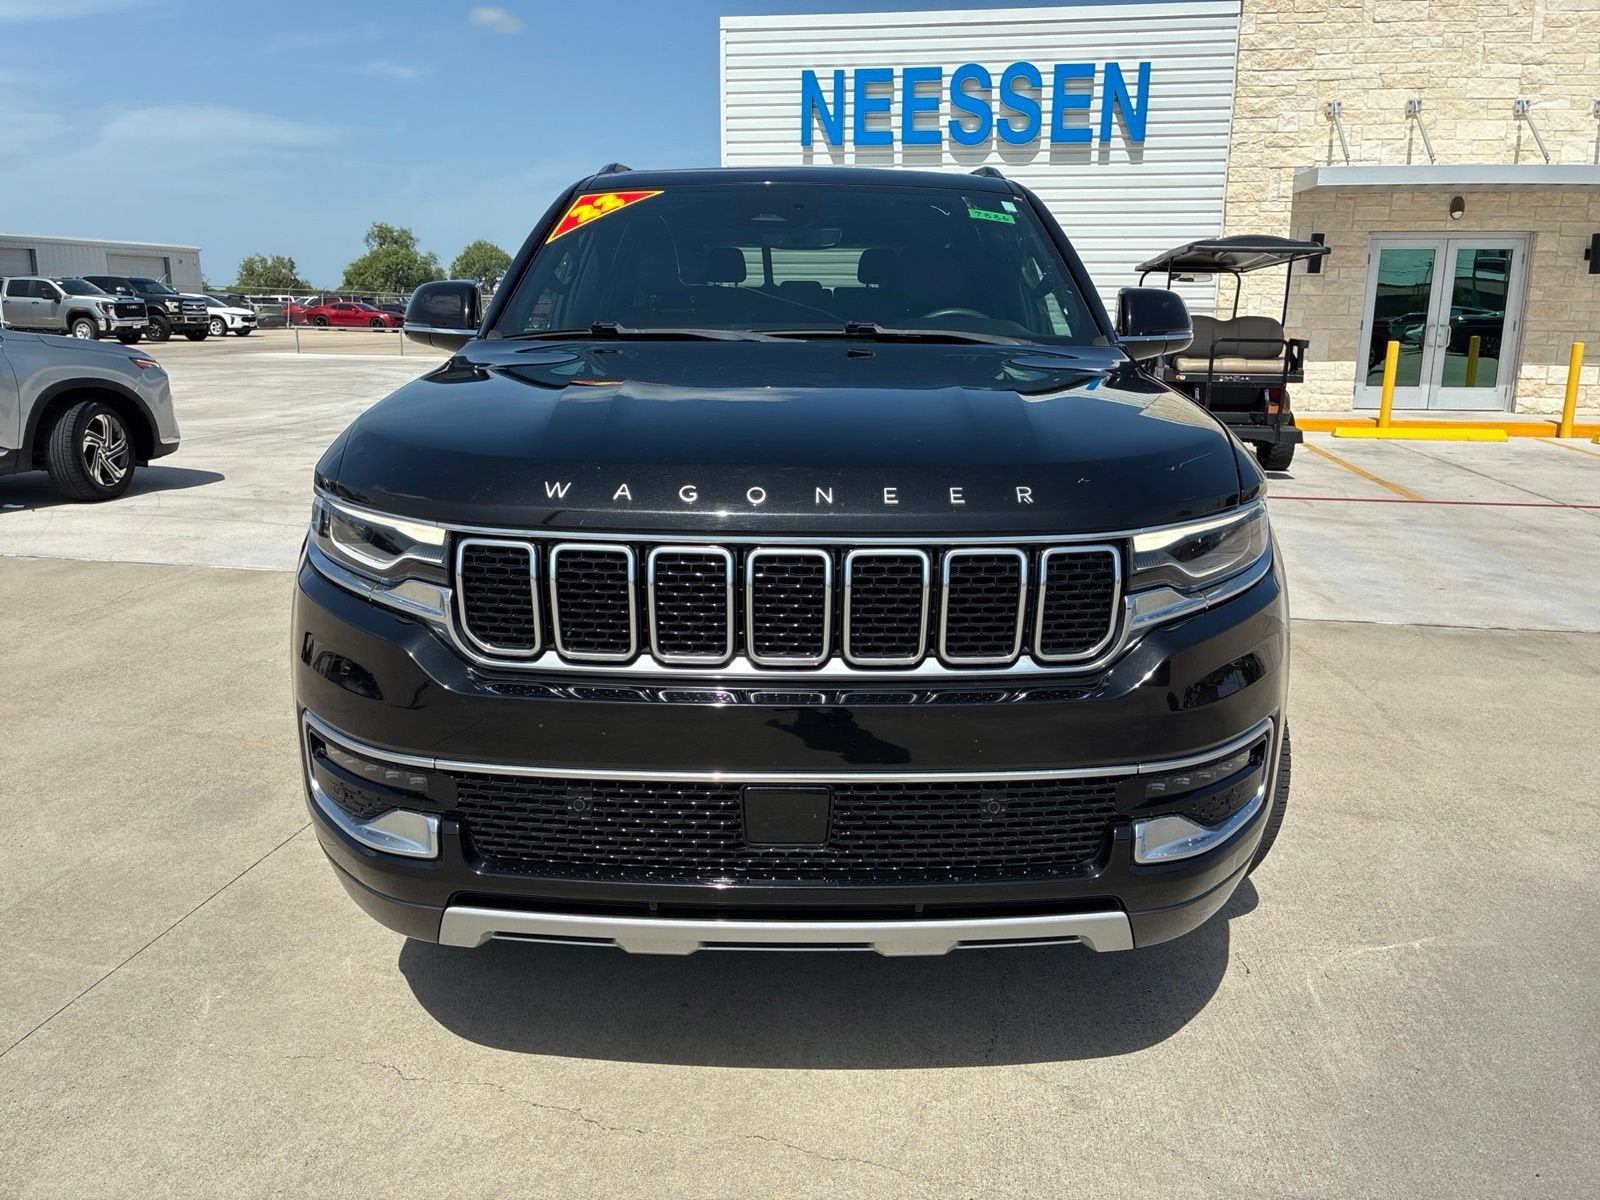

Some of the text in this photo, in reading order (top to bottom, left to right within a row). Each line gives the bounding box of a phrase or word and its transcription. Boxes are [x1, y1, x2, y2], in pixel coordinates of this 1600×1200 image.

[800, 61, 1152, 147] NEESSEN
[569, 193, 625, 223] 22
[544, 481, 1035, 505] WAGONEER
